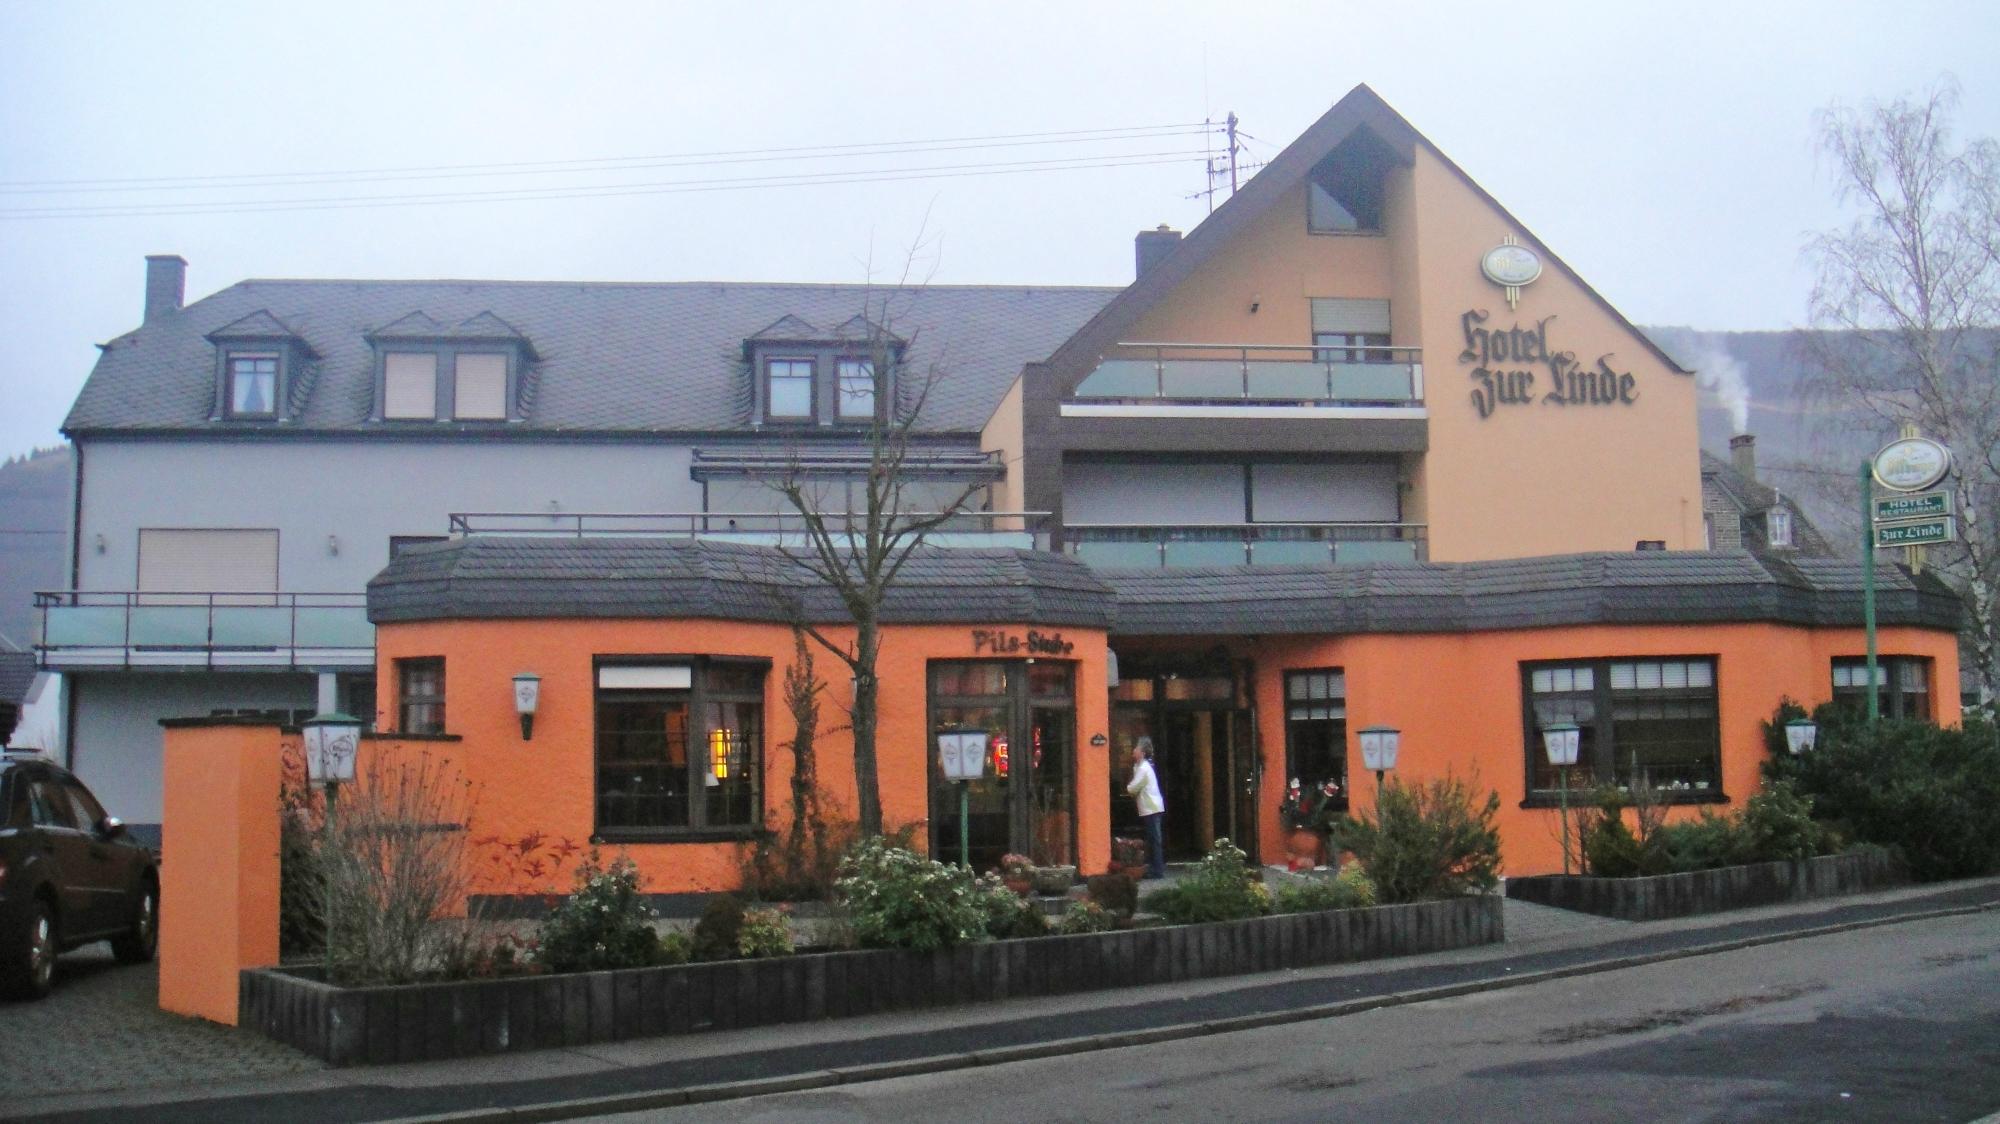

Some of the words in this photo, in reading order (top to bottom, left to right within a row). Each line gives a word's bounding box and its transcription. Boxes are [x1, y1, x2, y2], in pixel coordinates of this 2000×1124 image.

[1459, 309, 1557, 368] Hotel
[1541, 352, 1640, 406] Linde
[1890, 498, 1932, 508] HOTEL
[1880, 504, 1942, 516] RESTAURANT
[1905, 525, 1943, 538] Linde
